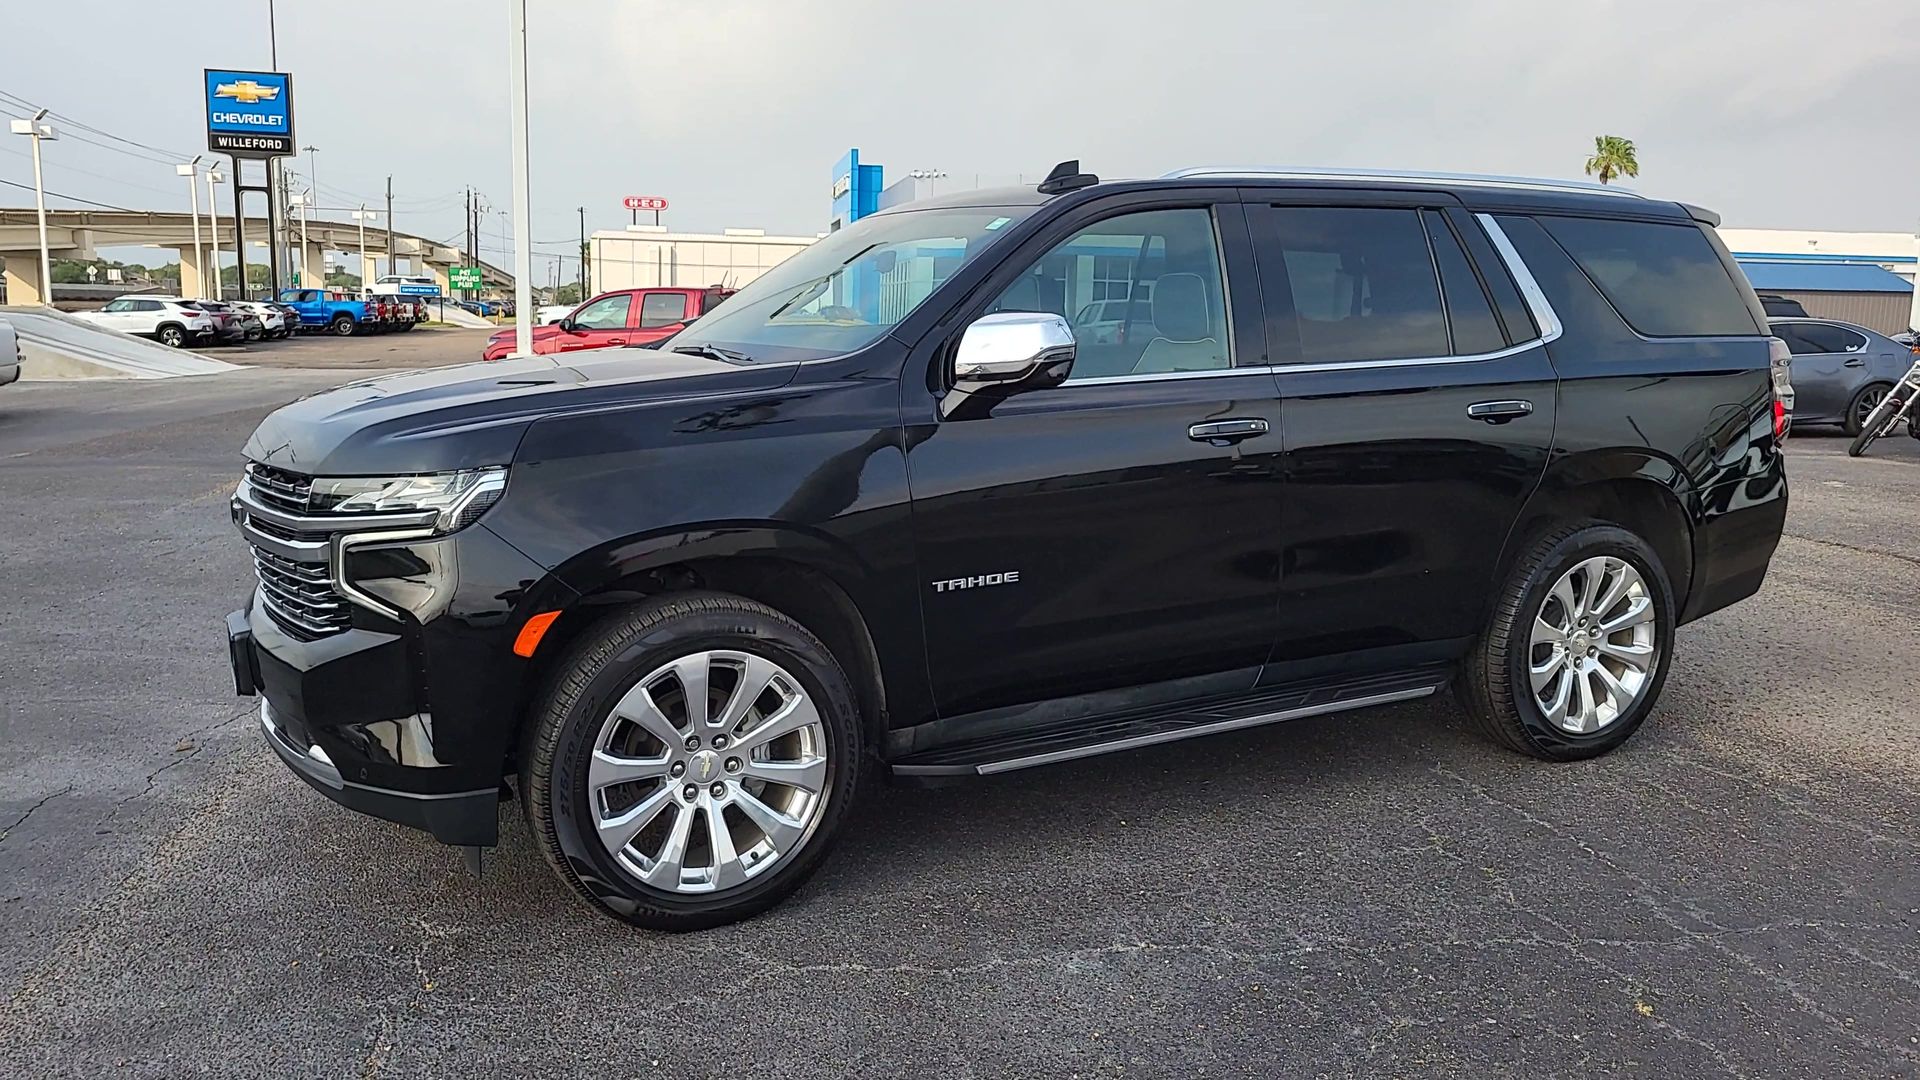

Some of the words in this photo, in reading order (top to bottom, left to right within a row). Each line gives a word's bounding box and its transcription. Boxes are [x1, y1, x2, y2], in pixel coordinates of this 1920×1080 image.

[213, 112, 283, 126] CHEVROLET
[218, 137, 282, 149] WILLEFORD
[932, 571, 1019, 592] TAHOE
[837, 703, 856, 820] SCORPION
[561, 741, 575, 818] 275/50
